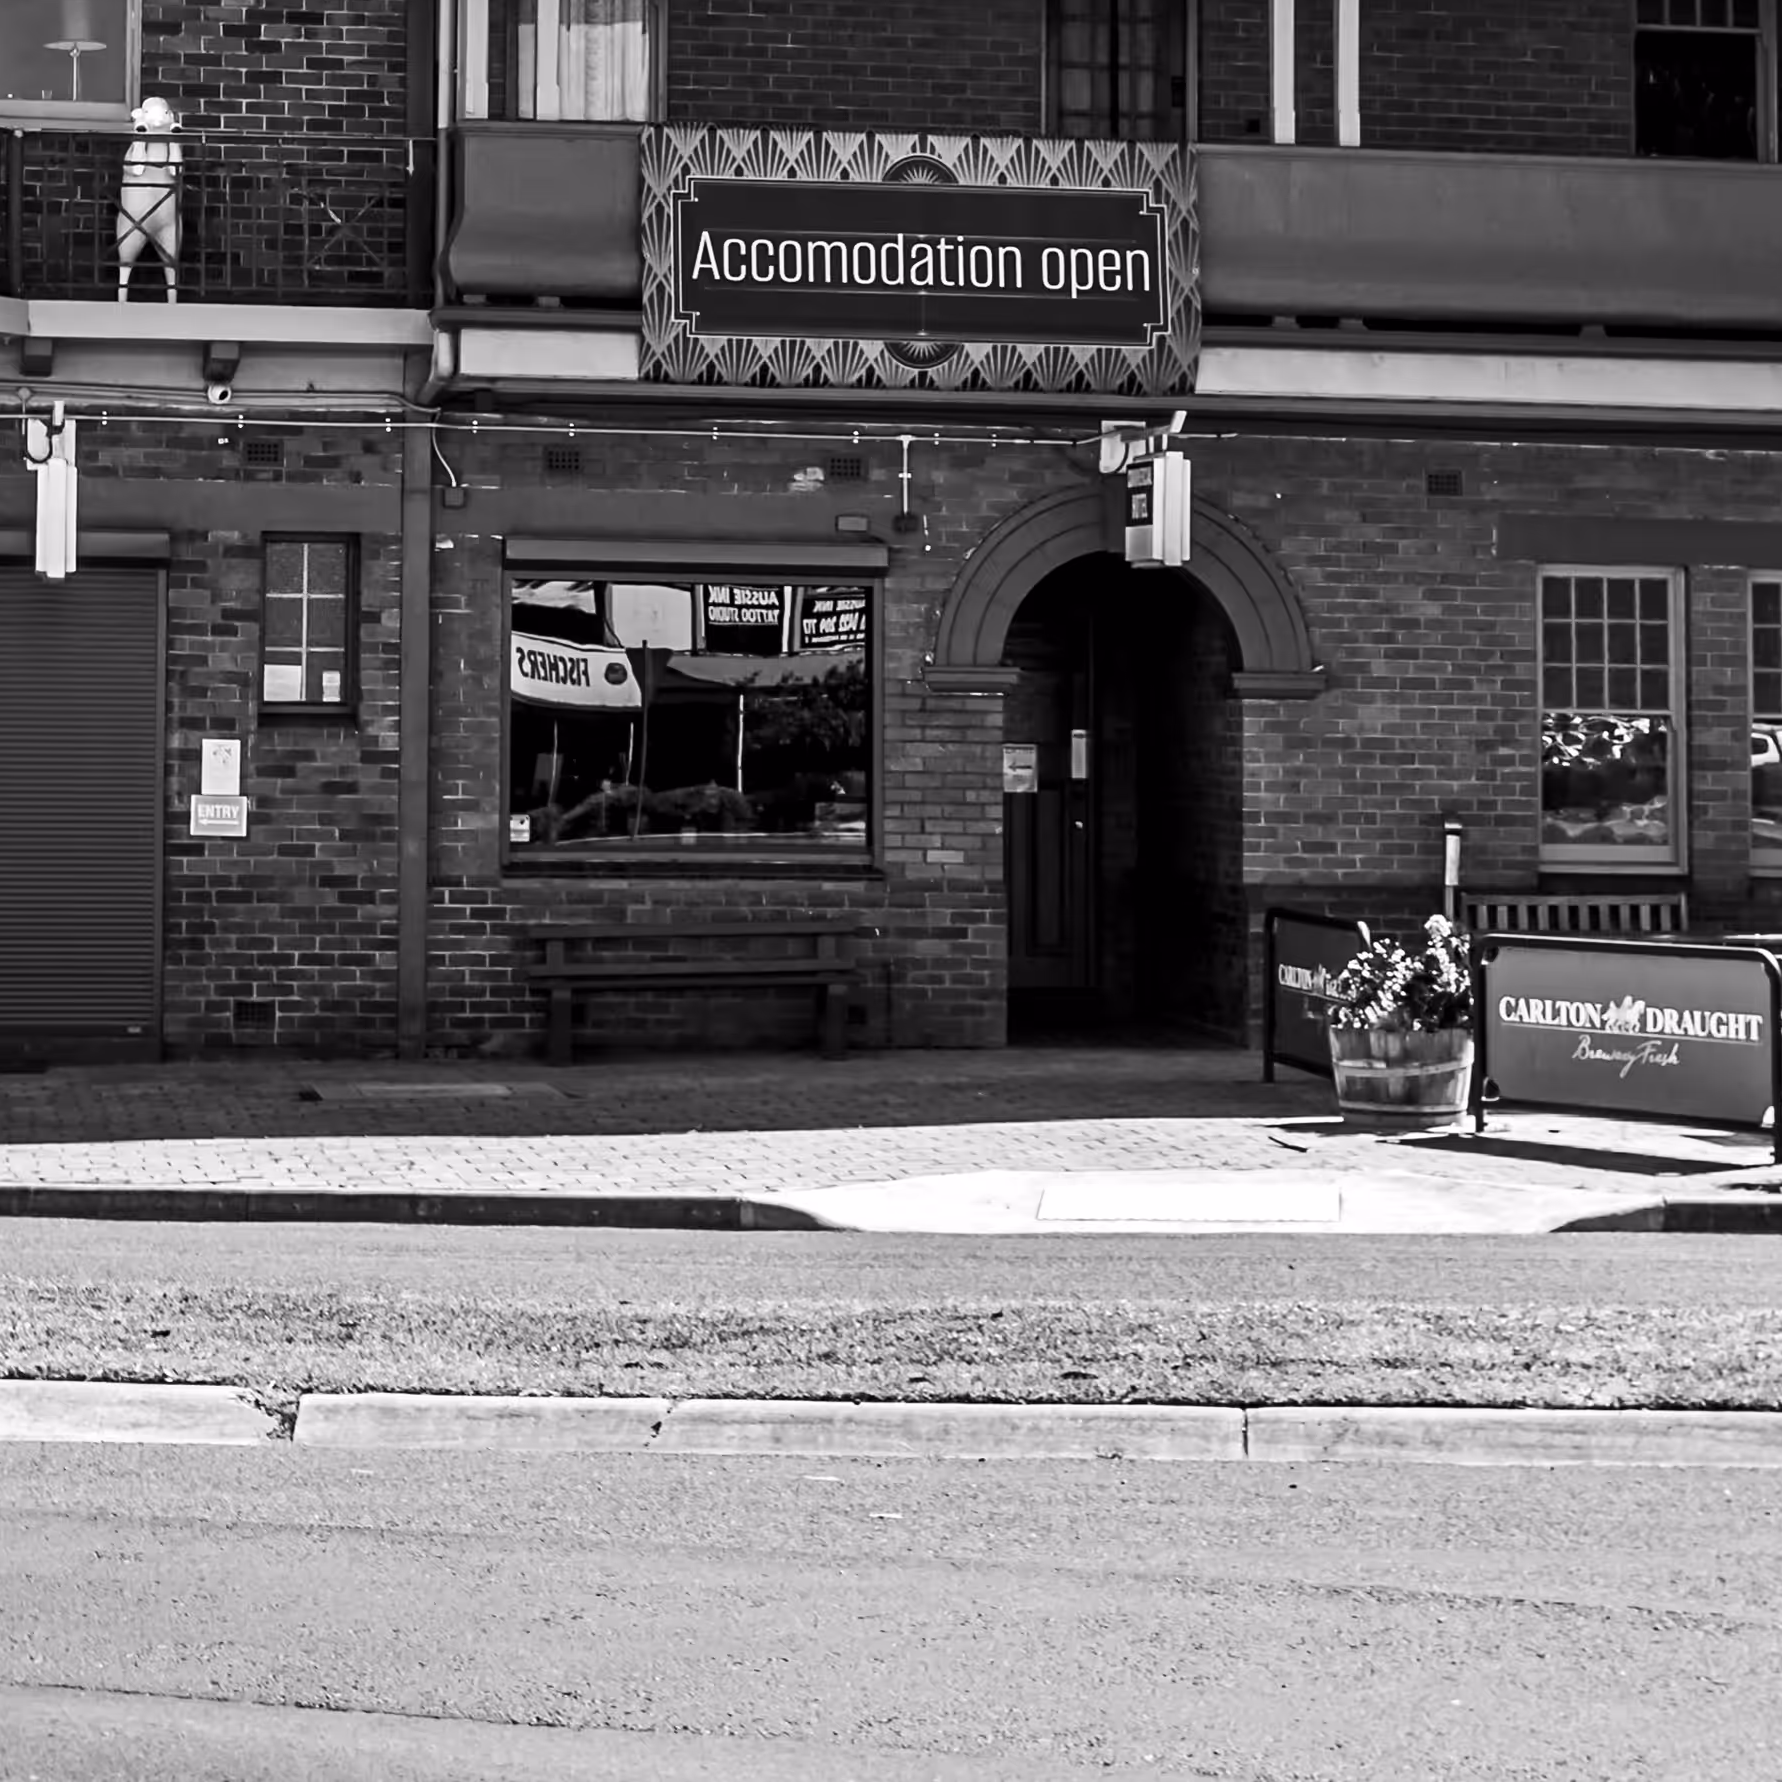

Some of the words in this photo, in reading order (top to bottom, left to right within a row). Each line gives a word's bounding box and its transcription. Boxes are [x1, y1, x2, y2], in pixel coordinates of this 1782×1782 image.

[692, 231, 1022, 288] Accomodation
[1041, 246, 1150, 298] open
[197, 803, 240, 819] ENTRY
[1499, 995, 1602, 1029] CARLTON
[1646, 1008, 1764, 1042] DRAUGHT
